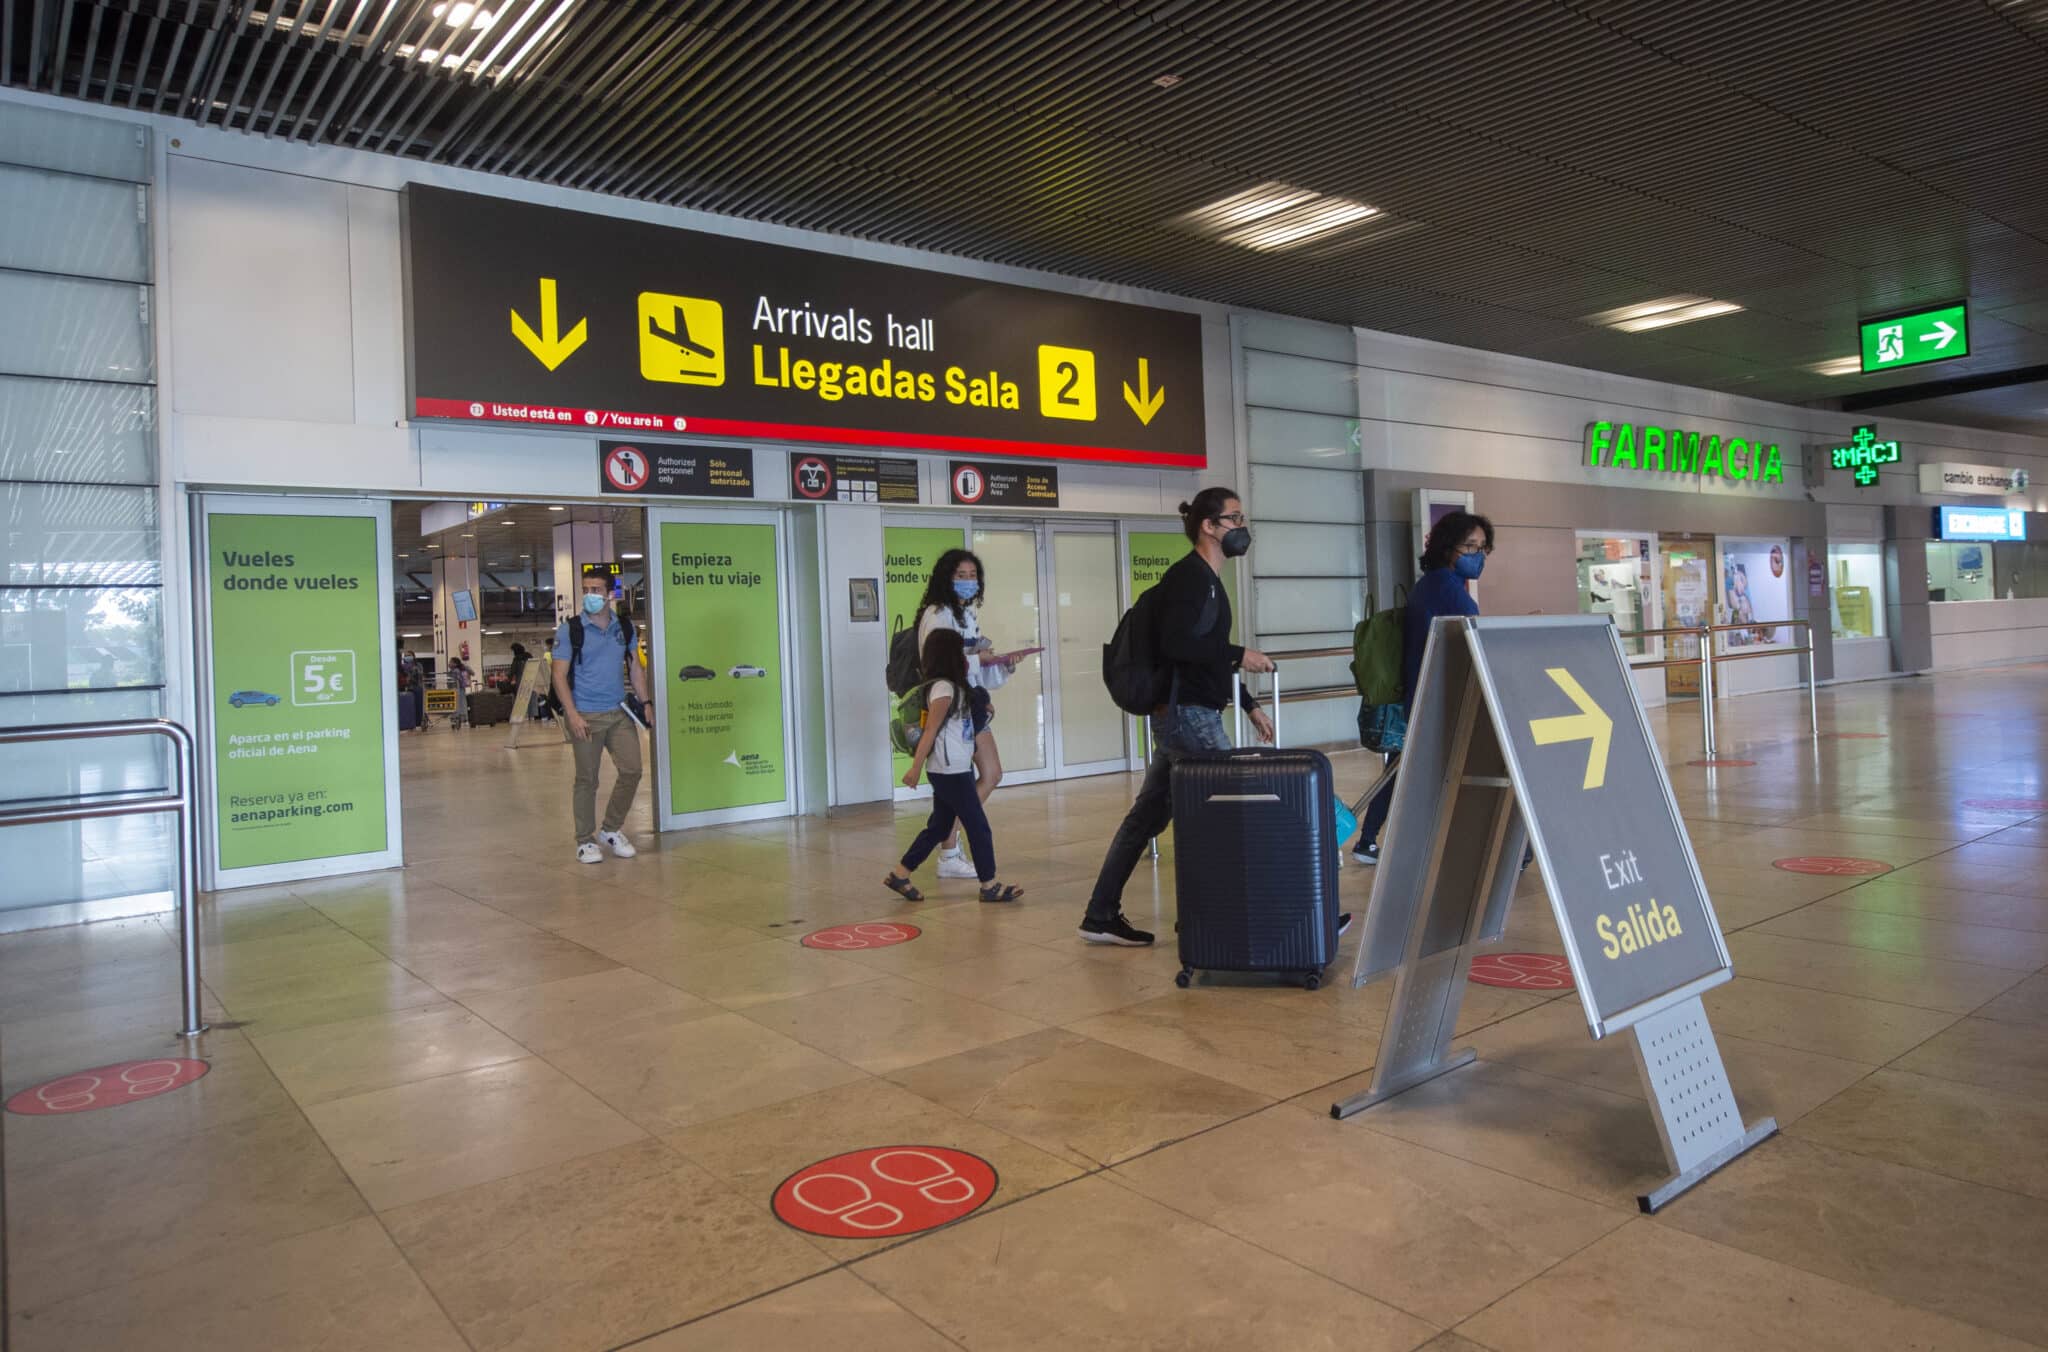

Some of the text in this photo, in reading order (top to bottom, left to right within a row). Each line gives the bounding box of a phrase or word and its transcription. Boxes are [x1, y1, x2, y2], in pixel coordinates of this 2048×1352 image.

[752, 296, 934, 351] Arrivals hall
[753, 344, 1080, 410] Llegadas Sala 2
[492, 404, 528, 418] Usted
[529, 407, 555, 420] está
[557, 411, 572, 421] en
[610, 414, 632, 426] You
[633, 416, 652, 427] are
[652, 416, 663, 428] in
[1588, 420, 1784, 485] FARMACIA
[657, 456, 697, 468] Authorized
[658, 466, 694, 476] personnel
[709, 467, 743, 479] personal
[658, 475, 674, 485] only
[709, 477, 751, 487] autorizado
[1943, 471, 2014, 491] cambio exchange
[222, 551, 295, 567] Vueles
[671, 552, 732, 569] Empieza
[1132, 555, 1170, 568] Empieza
[223, 574, 359, 590] donde vueles
[672, 571, 761, 588] bien tu viaje
[1133, 570, 1153, 581] bien
[303, 664, 344, 693] 5 €
[229, 727, 351, 746] Aparca en el parking
[228, 743, 318, 759] oficial de Aena
[230, 789, 328, 808] Reserva ya en:
[230, 801, 354, 823] aenaparking.com
[1600, 849, 1643, 890] Exit
[1596, 898, 1683, 960] Salida
